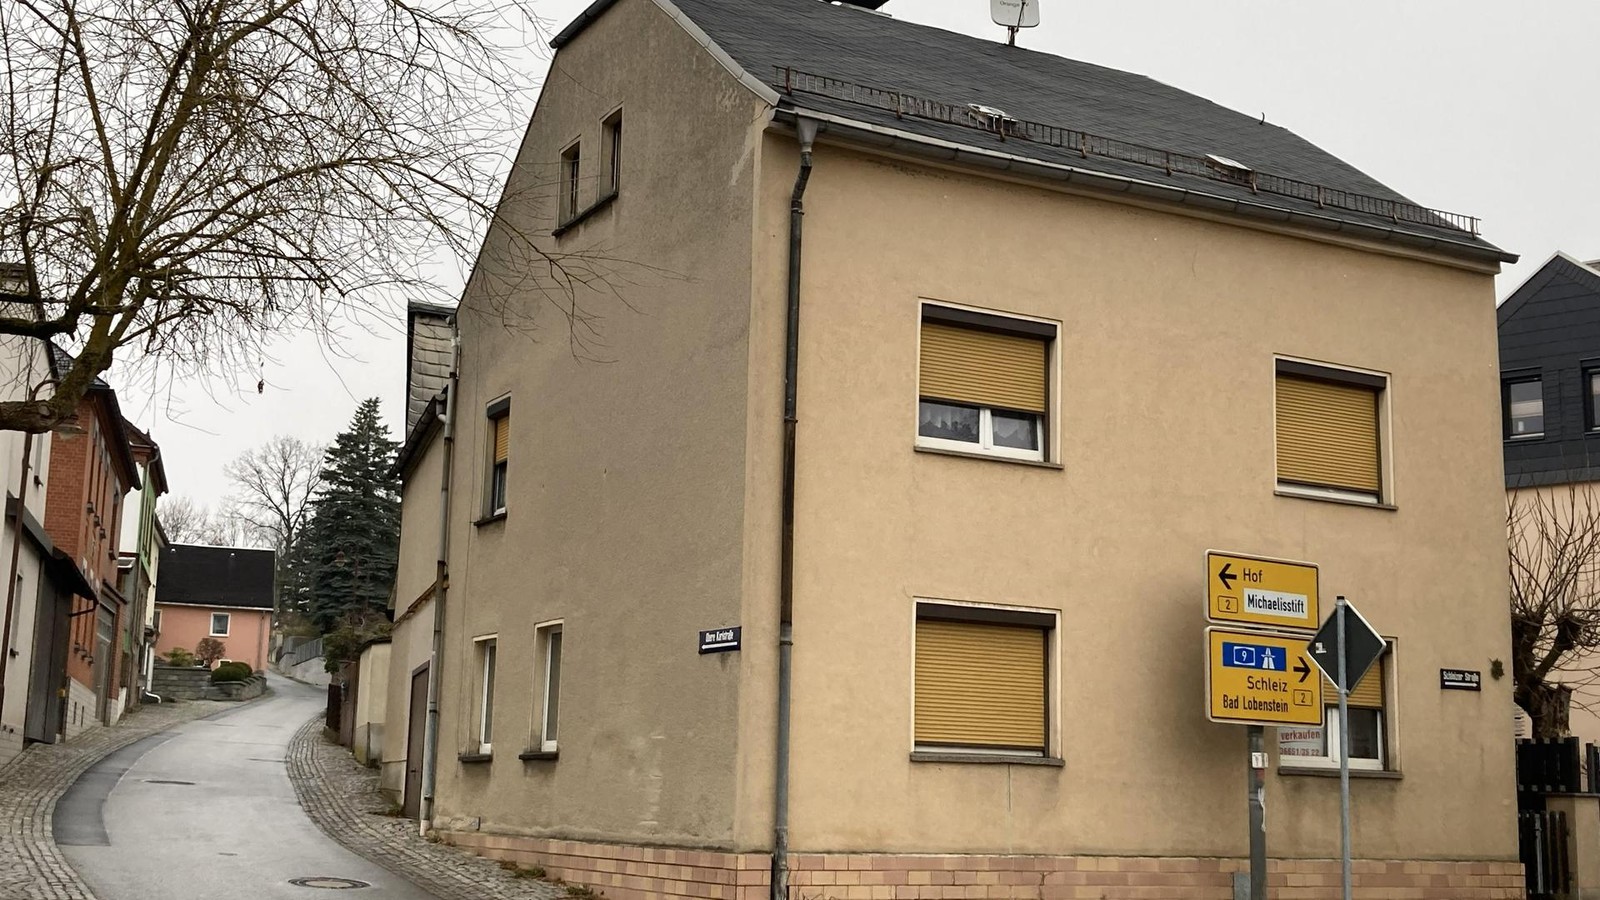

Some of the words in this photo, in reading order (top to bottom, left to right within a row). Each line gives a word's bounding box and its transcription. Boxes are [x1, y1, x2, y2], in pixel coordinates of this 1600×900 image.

[1243, 568, 1262, 583] Hof
[1225, 599, 1231, 610] 2
[1247, 593, 1305, 614] Michaelisstift
[1241, 650, 1248, 662] 9
[1247, 675, 1288, 693] Schleiz
[1223, 694, 1239, 709] Bad
[1242, 696, 1289, 713] Lobenstein
[1300, 692, 1306, 704] 2
[1281, 730, 1320, 741] verkaufen
